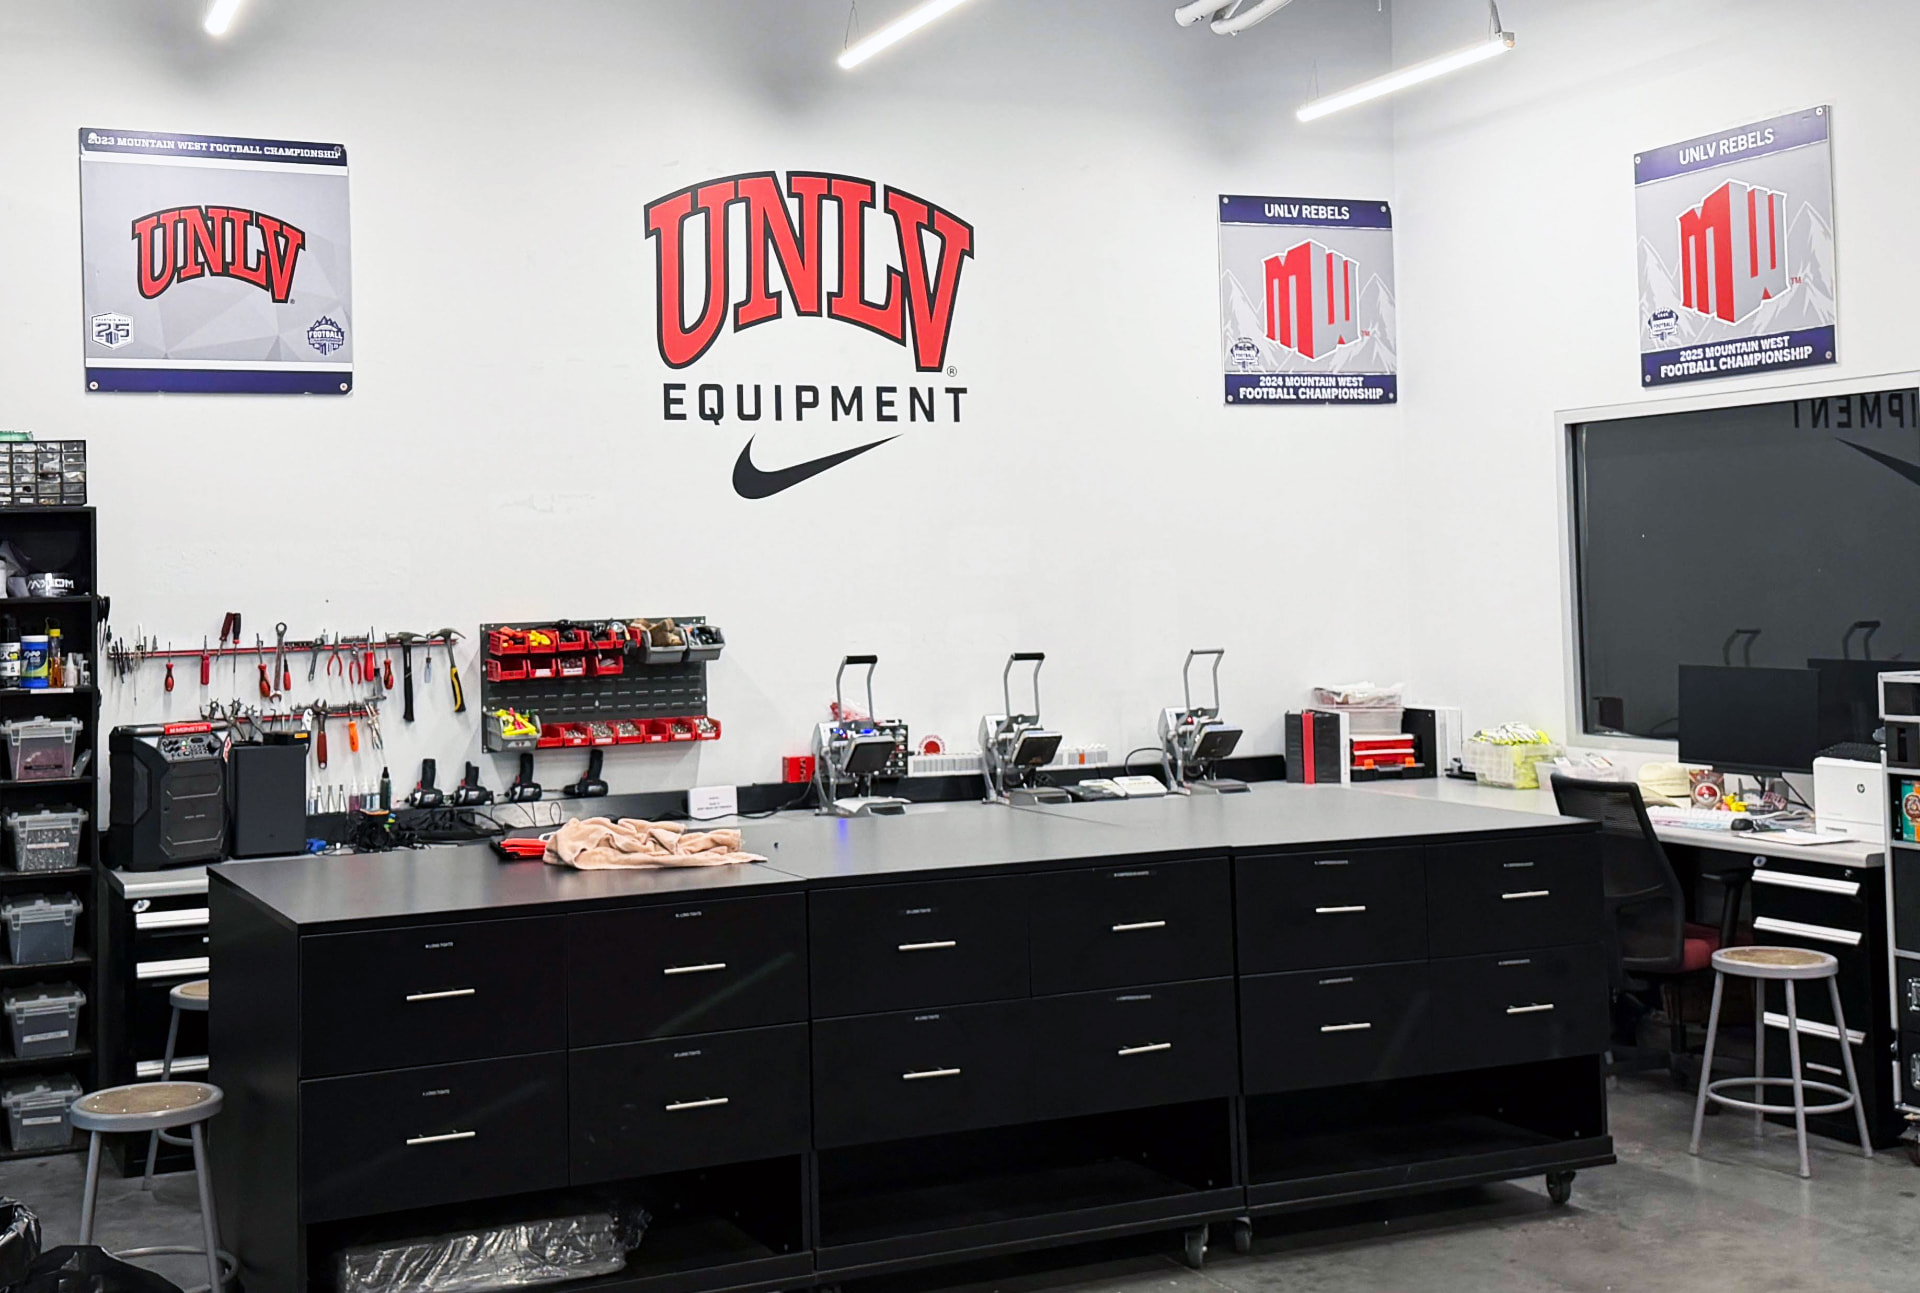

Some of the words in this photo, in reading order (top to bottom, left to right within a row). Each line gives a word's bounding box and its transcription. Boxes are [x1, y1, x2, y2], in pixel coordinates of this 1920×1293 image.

[88, 135, 115, 146] 2023
[117, 137, 175, 150] MOUNTAIN
[177, 141, 208, 151] WEST
[209, 142, 263, 155] FOOTBALL
[263, 146, 342, 159] CHAMPIONSHIP
[1679, 141, 1718, 165] UNLV
[1719, 128, 1775, 155] REBELS
[1264, 203, 1300, 218] UNLV
[1302, 204, 1350, 220] REBELS
[131, 204, 306, 304] UNLV
[643, 170, 975, 373] UNLV
[308, 330, 344, 339] FOOTBALL
[1660, 359, 1718, 378] FOOTBALL
[1719, 345, 1813, 370] CHAMPIONSHIP
[1679, 348, 1704, 362] 2025
[1705, 340, 1759, 358] MOUNTAIN
[1760, 335, 1790, 350] WEST
[1239, 387, 1297, 399] FOOTBALL
[1298, 387, 1384, 400] CHAMPIONSHIP
[1259, 376, 1284, 387] 2024
[1285, 376, 1337, 387] MOUNTAIN
[1337, 377, 1364, 387] WEST
[663, 383, 968, 425] EQUIPMENT
